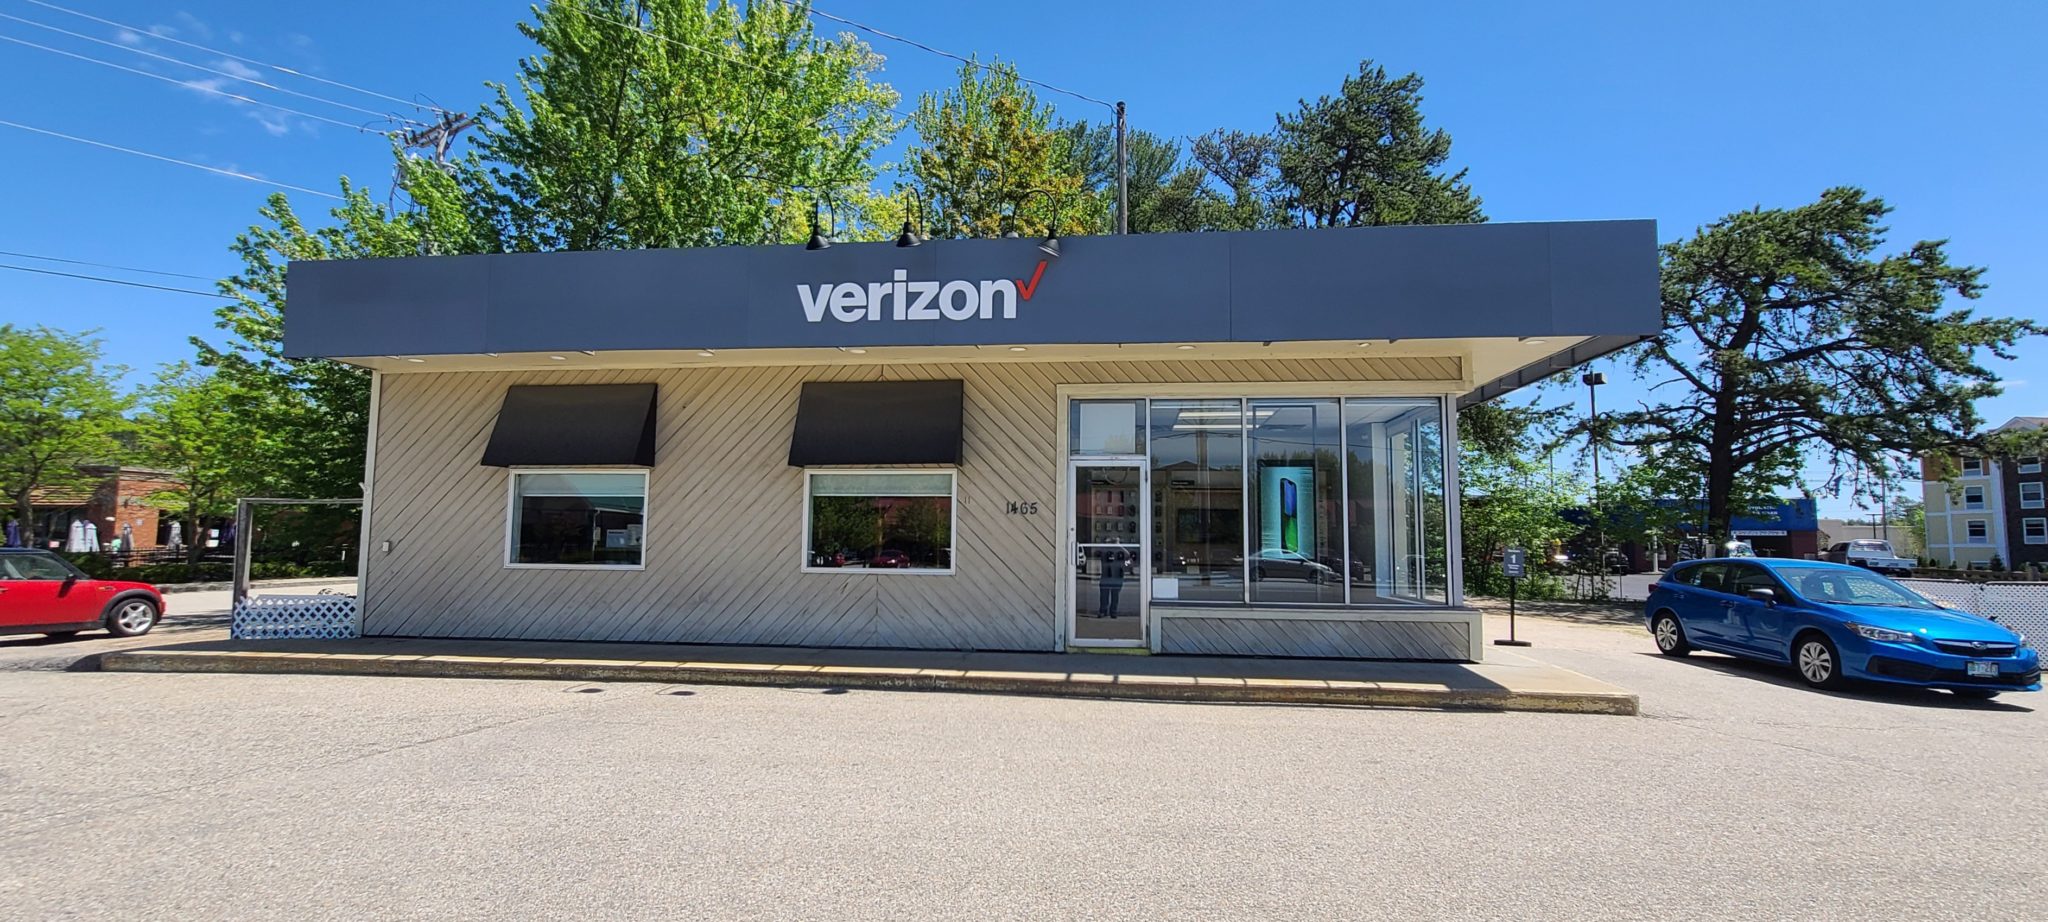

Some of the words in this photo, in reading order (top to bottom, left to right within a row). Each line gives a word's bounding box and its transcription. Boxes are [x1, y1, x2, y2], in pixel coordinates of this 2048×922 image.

[797, 269, 1017, 322] verizon
[1006, 501, 1038, 515] 1465
[1510, 554, 1516, 563] 1
